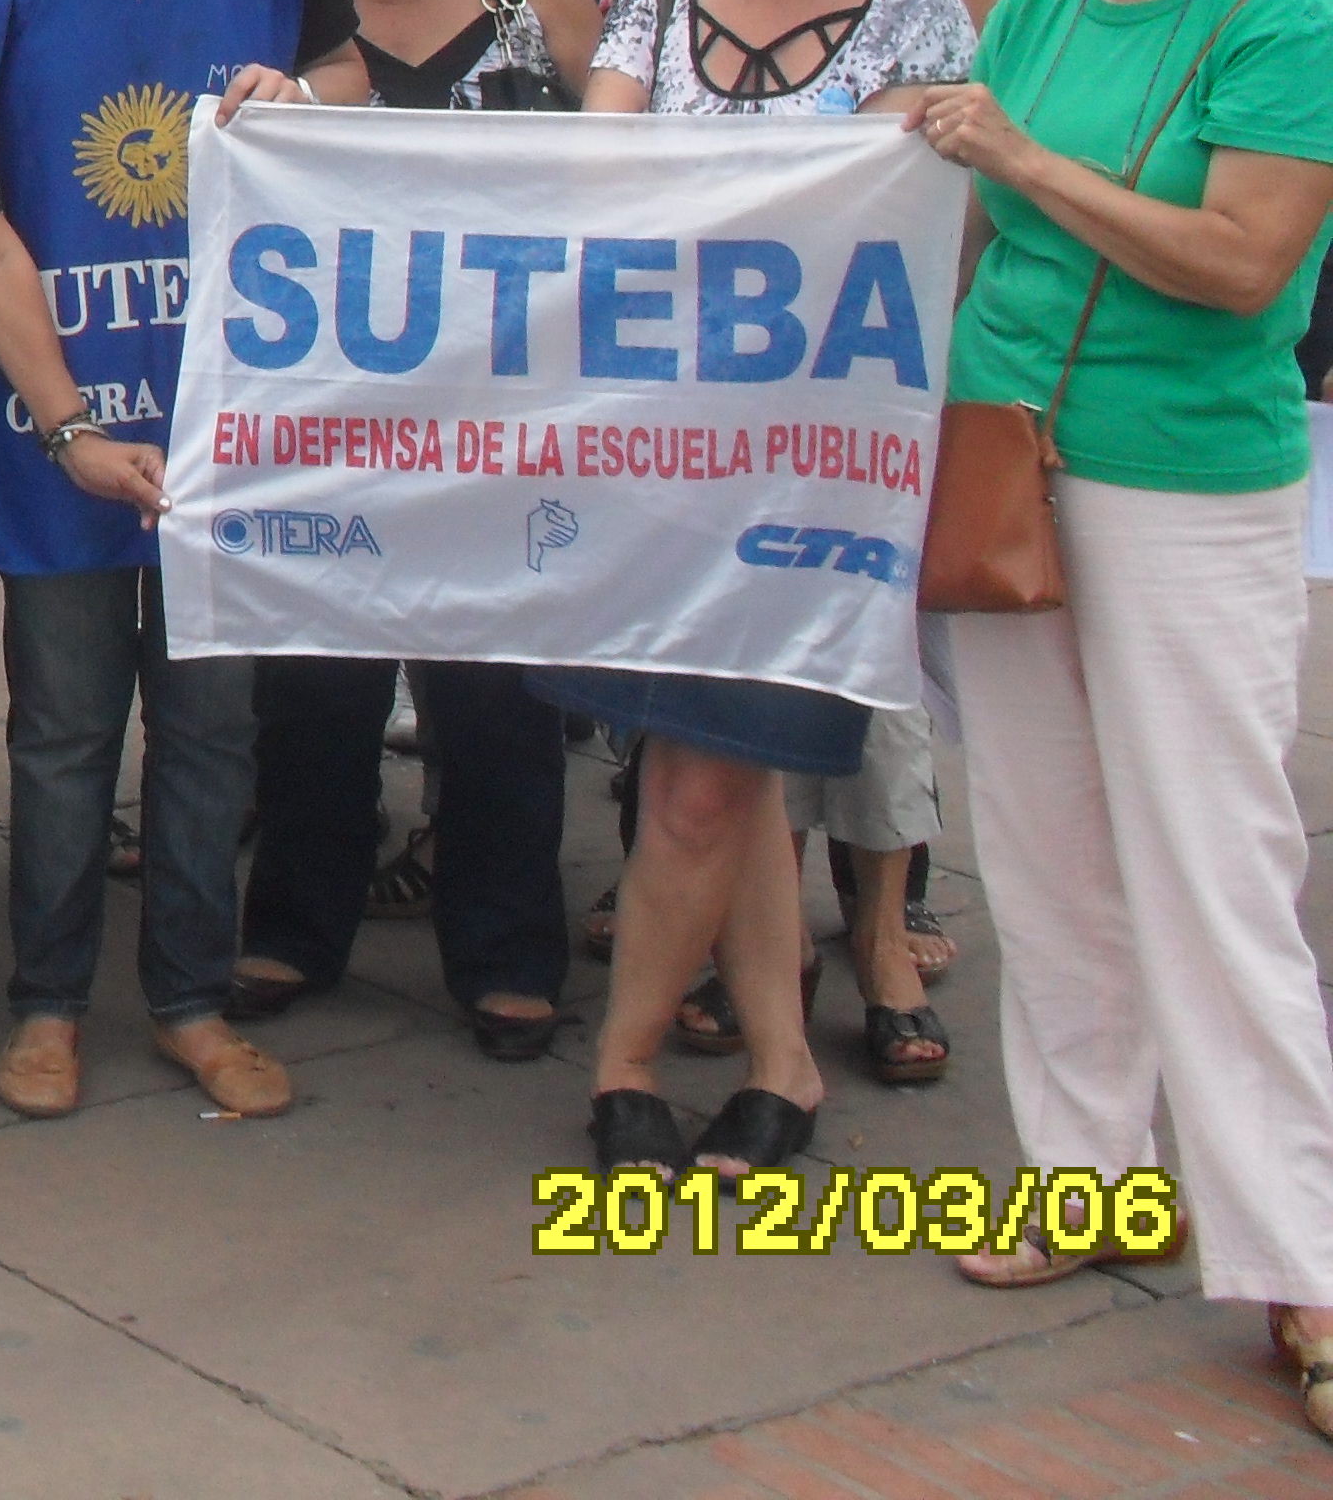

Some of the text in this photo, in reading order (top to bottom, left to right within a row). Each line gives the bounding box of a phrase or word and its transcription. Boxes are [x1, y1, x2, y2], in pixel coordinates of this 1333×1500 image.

[39, 257, 189, 336] UTE
[221, 222, 930, 392] SUTEBA
[6, 377, 164, 434] CERA
[212, 412, 922, 496] EN DEFENSA DE LA ESCUELA PUBLICA
